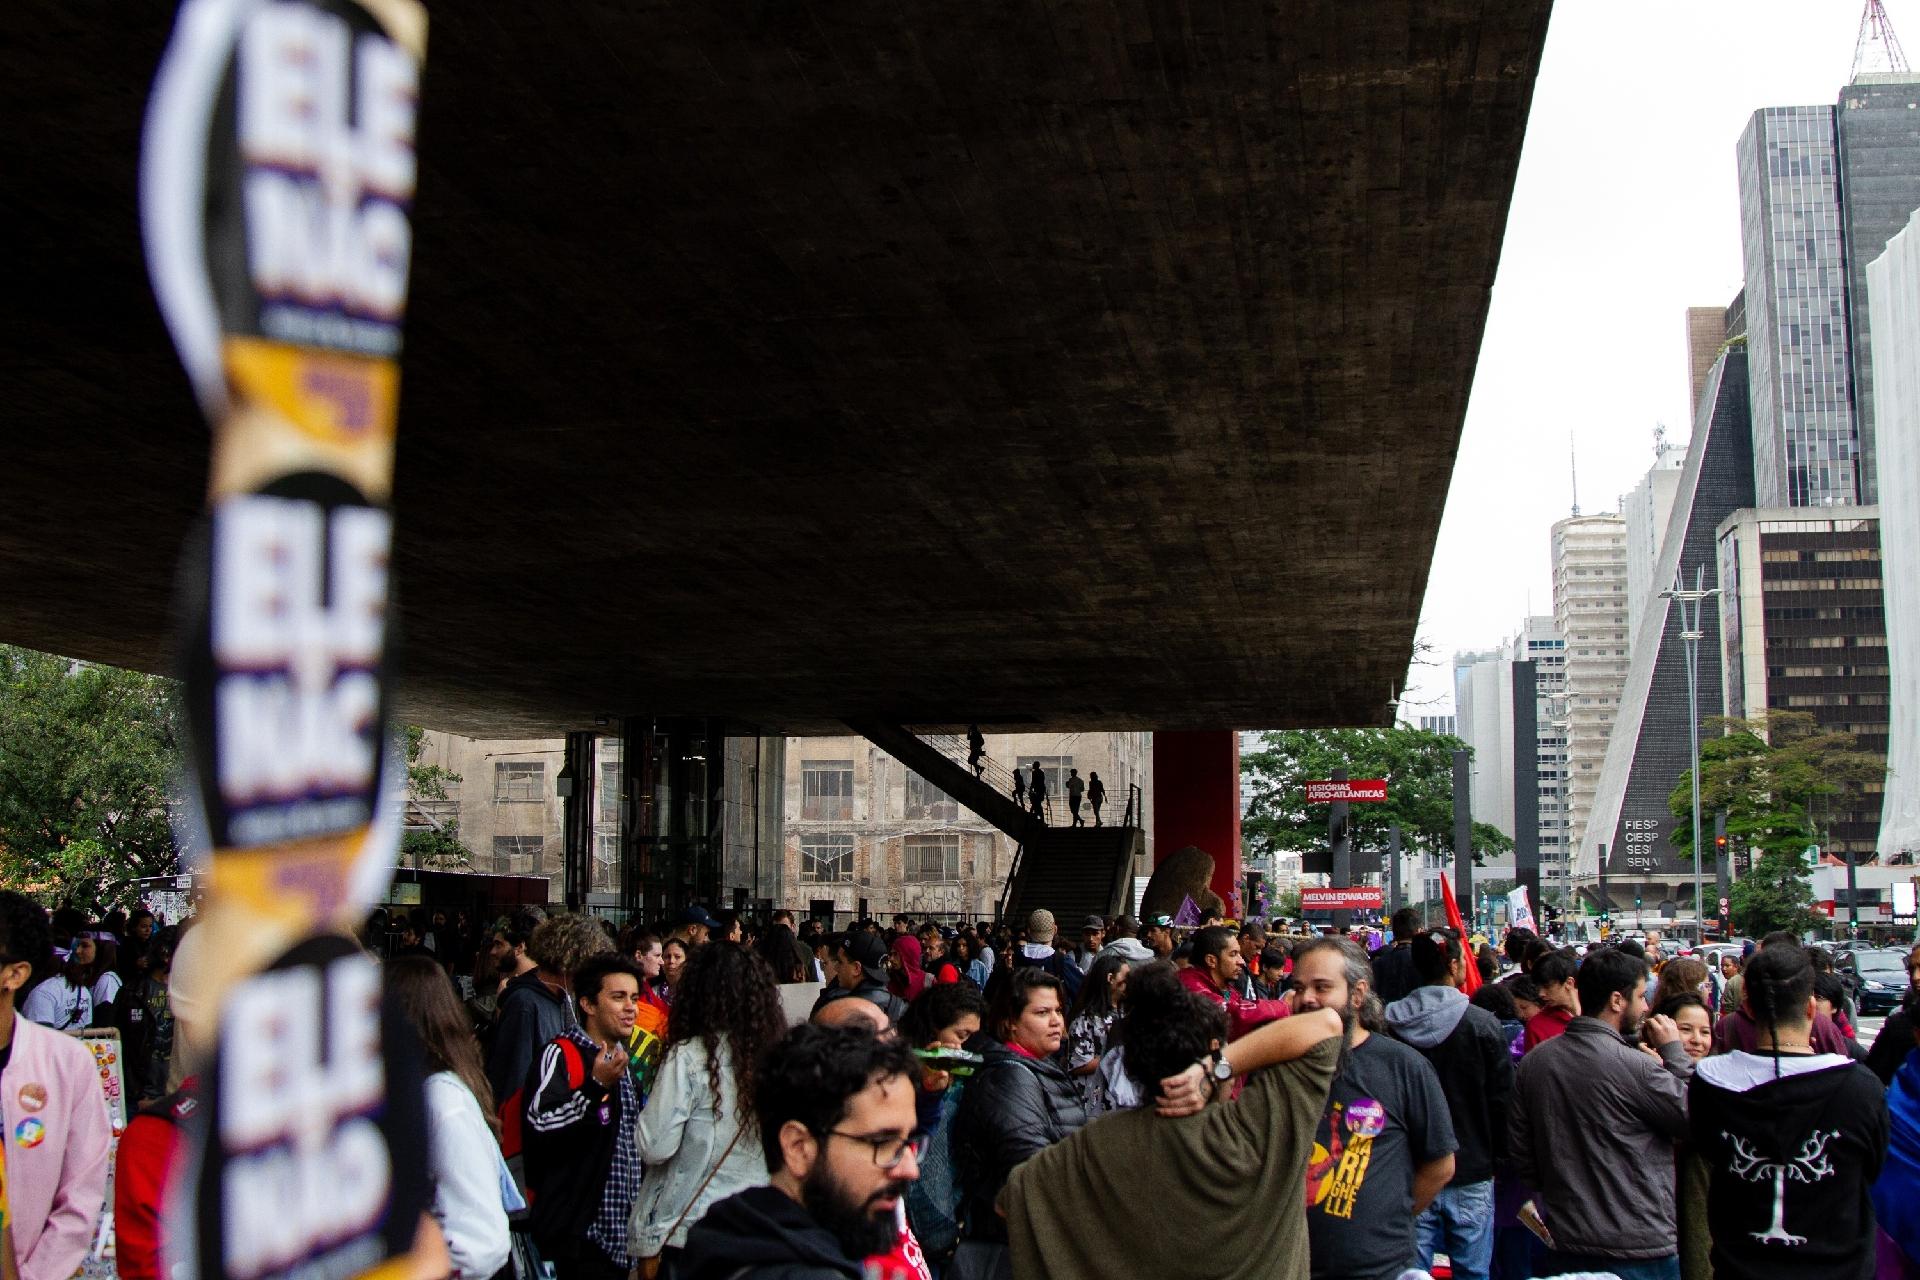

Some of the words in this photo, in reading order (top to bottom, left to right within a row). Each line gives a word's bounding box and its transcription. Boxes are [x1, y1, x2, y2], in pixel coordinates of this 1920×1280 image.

[1308, 783, 1350, 791] HISTÓRIAS
[1308, 790, 1385, 798] AFRO-ATLÂNTICAS
[1625, 820, 1658, 830] FIESP
[1625, 832, 1659, 842] CIESP
[1626, 844, 1652, 854] SESI
[1303, 893, 1336, 901] MELVIN
[1337, 892, 1380, 900] EDWARDS
[1336, 1149, 1370, 1187] RI
[1331, 1181, 1360, 1202] GHE
[1324, 1195, 1353, 1219] LLA
